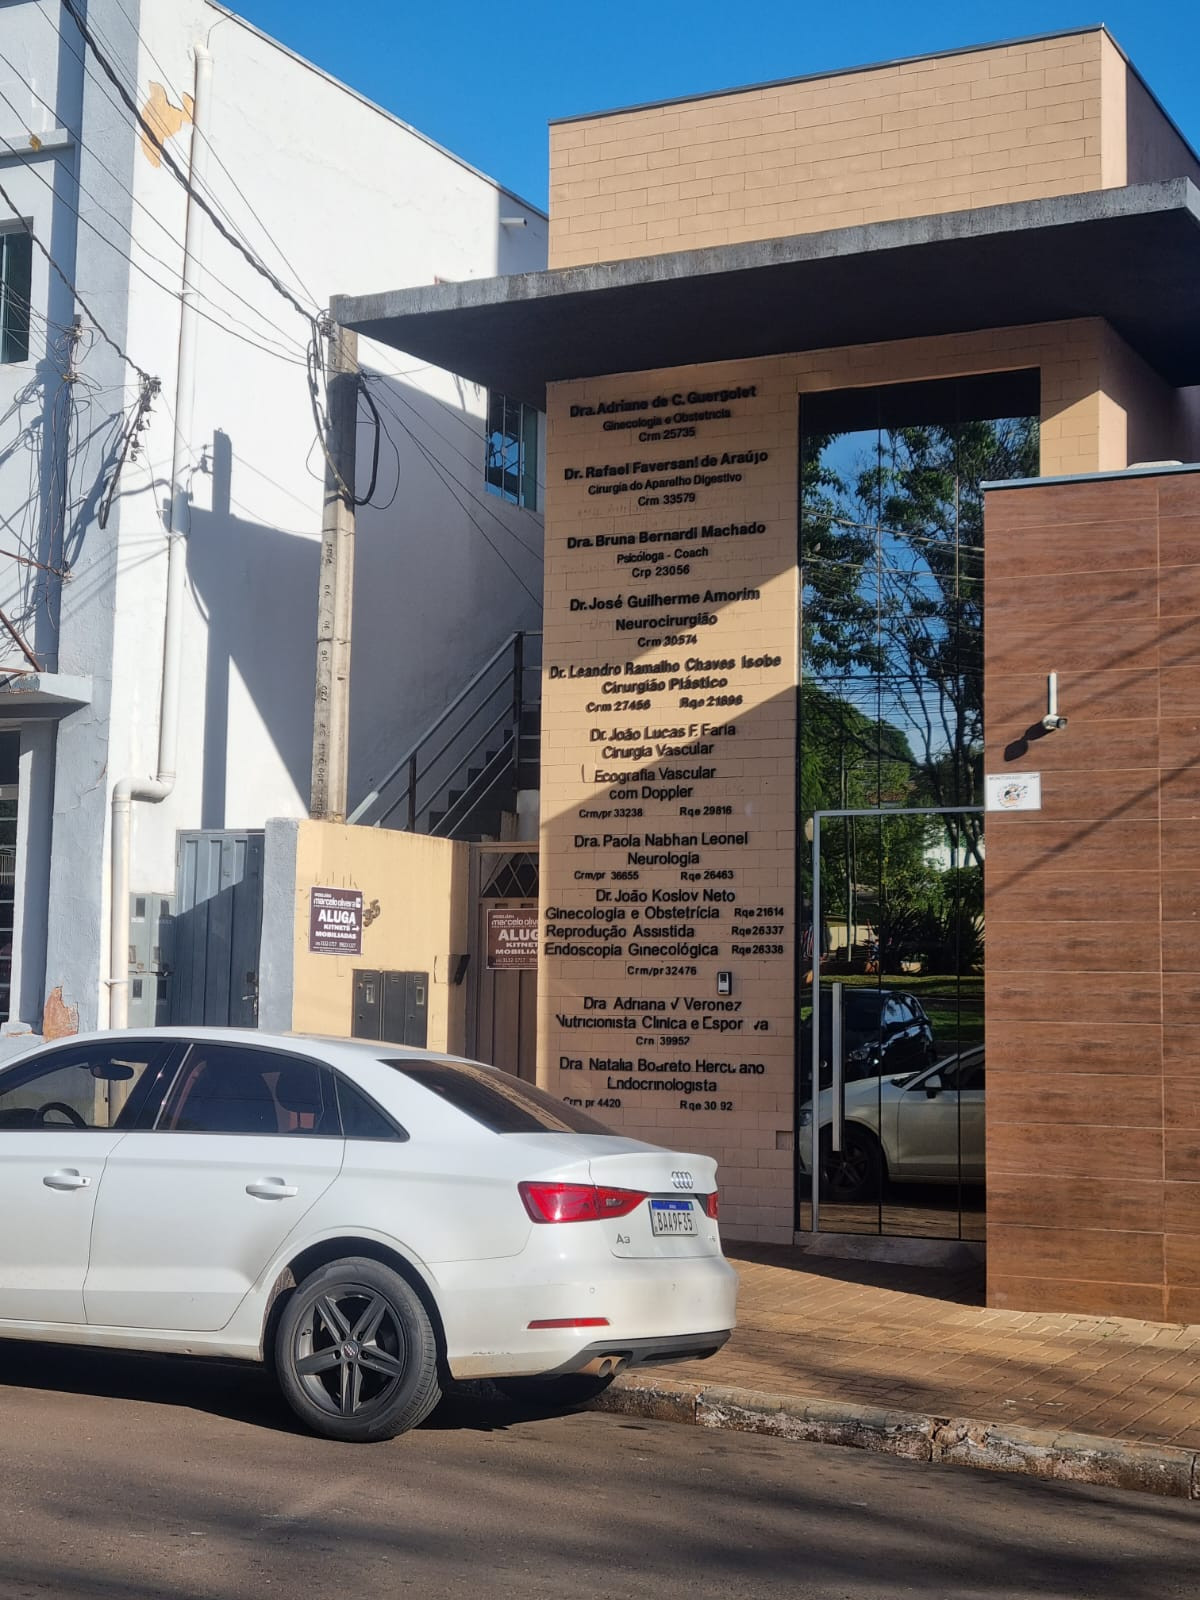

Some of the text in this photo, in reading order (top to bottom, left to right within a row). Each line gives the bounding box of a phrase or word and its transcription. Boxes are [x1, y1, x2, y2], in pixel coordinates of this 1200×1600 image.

[653, 396, 668, 408] de
[603, 416, 662, 431] Ginecologia
[665, 416, 672, 424] e
[639, 427, 696, 442] Crm 25735
[564, 468, 582, 480] Dr.
[586, 462, 630, 478] Rafael
[701, 456, 718, 468] de
[720, 450, 768, 465] Araújo
[588, 472, 742, 495] Cirurgia do Aparelho Digestivo
[638, 493, 696, 507] Crm 33579
[568, 522, 766, 548] Dra. Bruna Bernardi Machado
[617, 550, 664, 565] Psicóloga
[674, 546, 708, 559] Coach
[632, 564, 690, 579] Crp 23056
[570, 588, 760, 611] Dr. José Guilherme Amorim
[616, 612, 718, 631] Neurocirurgião
[638, 638, 661, 648] Crm
[550, 654, 782, 680] Dr. Leandro Ramalho Chaves Isobe
[602, 675, 728, 695] Cirurgião Plástico
[586, 702, 612, 713] Crm
[590, 723, 736, 742] Dr. João Lucas F. Faria
[602, 742, 715, 761] Cirurgia Vascular
[594, 766, 716, 784] Ecografia Vascular
[610, 786, 694, 801] com Doppler
[579, 808, 612, 819] Crm/pr
[614, 808, 643, 818] 33238
[679, 806, 700, 817] Rqe
[574, 832, 748, 848] Dra. Paola Nabhan Leonel
[628, 852, 700, 867] Neurologia
[574, 871, 606, 880] Crm/pr
[680, 872, 700, 882] Rqe
[596, 888, 736, 902] Dr. João Koslov Neto
[318, 909, 356, 924] ALUGA
[524, 916, 538, 926] oliv
[546, 907, 625, 922] Ginecologia
[630, 910, 639, 918] e
[644, 906, 720, 920] Obstetrícia
[734, 908, 754, 918] Rqe
[315, 930, 356, 940] MOBILIADAS
[498, 929, 538, 940] ALUG
[546, 925, 626, 940] Reprodução
[633, 925, 694, 938] Assistida
[732, 926, 751, 937] Rqe
[544, 943, 622, 958] Endoscopia
[628, 943, 718, 958] Ginecológica
[732, 946, 751, 956] Rqe
[627, 966, 664, 977] Crm/pr
[584, 997, 606, 1009] Dra
[614, 997, 666, 1010] Adriana
[684, 997, 742, 1011] Veronez
[691, 1020, 699, 1029] e
[636, 1036, 654, 1045] Crn
[560, 1057, 582, 1070] Dra
[696, 1060, 764, 1074] Hercuano
[680, 1100, 702, 1112] Rqe
[616, 1234, 630, 1244] A3
